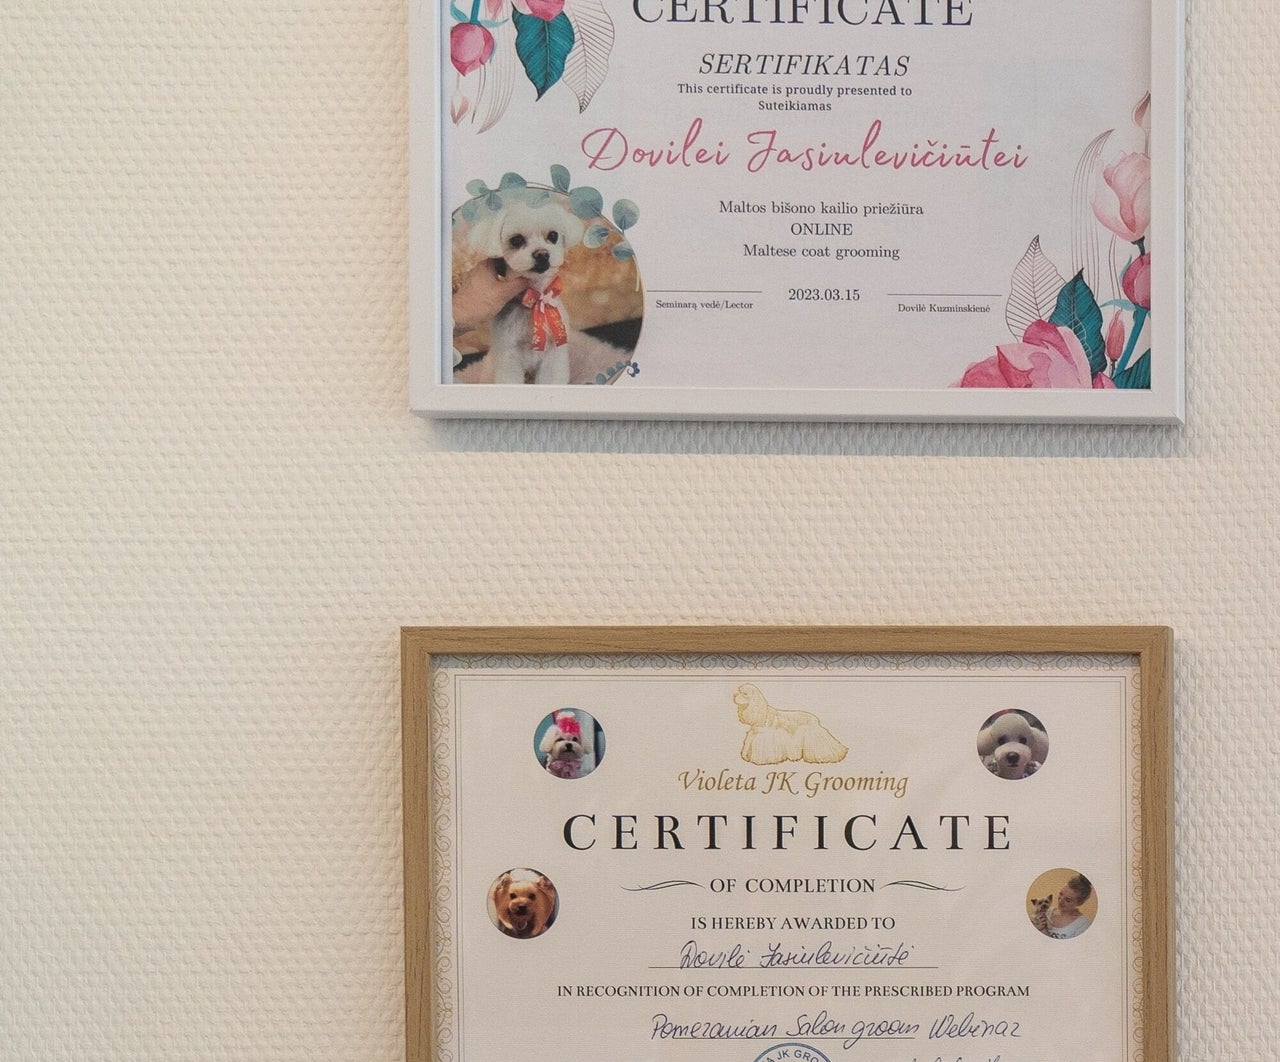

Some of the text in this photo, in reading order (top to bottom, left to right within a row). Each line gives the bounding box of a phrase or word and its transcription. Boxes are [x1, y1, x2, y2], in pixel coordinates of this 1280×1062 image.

[633, 0, 972, 26] CERTIFICATE
[699, 54, 910, 77] SERTIFIKATAS
[678, 83, 912, 98] This certificate is proudly presented to
[758, 100, 832, 111] Suteikiamas
[581, 118, 731, 171] Dovilei
[720, 200, 924, 217] Maltos bišono kailio priežiūra
[790, 223, 853, 237] ONLINE
[744, 244, 900, 261] Maltese coat grooming
[788, 288, 860, 301] 2023.03.15
[678, 770, 909, 799] Violeta JK Grooming
[563, 814, 1010, 851] CERTIFICATE
[710, 878, 876, 893] OF COMPLETION
[691, 916, 896, 930] IS HEREBY AWARDED TO
[557, 986, 1030, 998] IN RECOGNITION OF COMPLETION OF THE PRESCRIBED PROGRAM
[777, 1049, 790, 1060] JK
